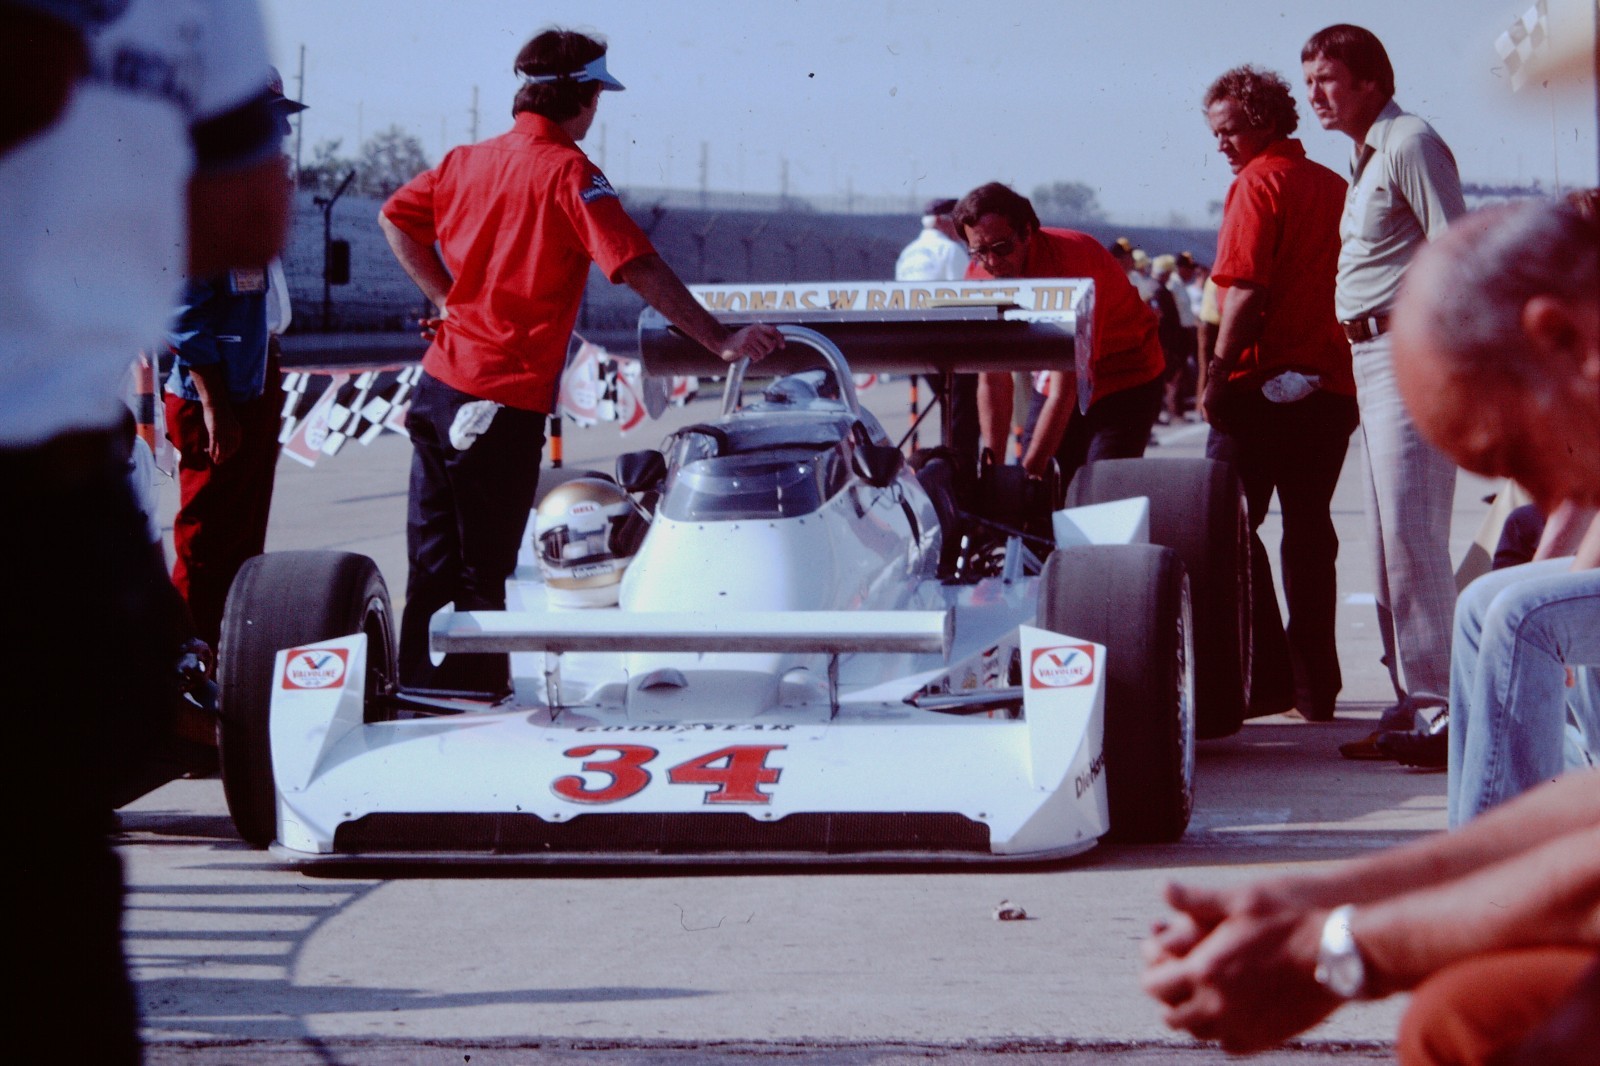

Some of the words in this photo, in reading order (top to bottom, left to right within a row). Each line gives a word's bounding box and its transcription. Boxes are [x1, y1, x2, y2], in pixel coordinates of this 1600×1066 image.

[697, 290, 818, 311] HOMAS
[1032, 287, 1077, 311] III
[572, 505, 595, 515] BELL
[292, 669, 336, 678] VALVOLINE
[1038, 666, 1083, 677] VALVOLINE
[550, 743, 788, 805] 34
